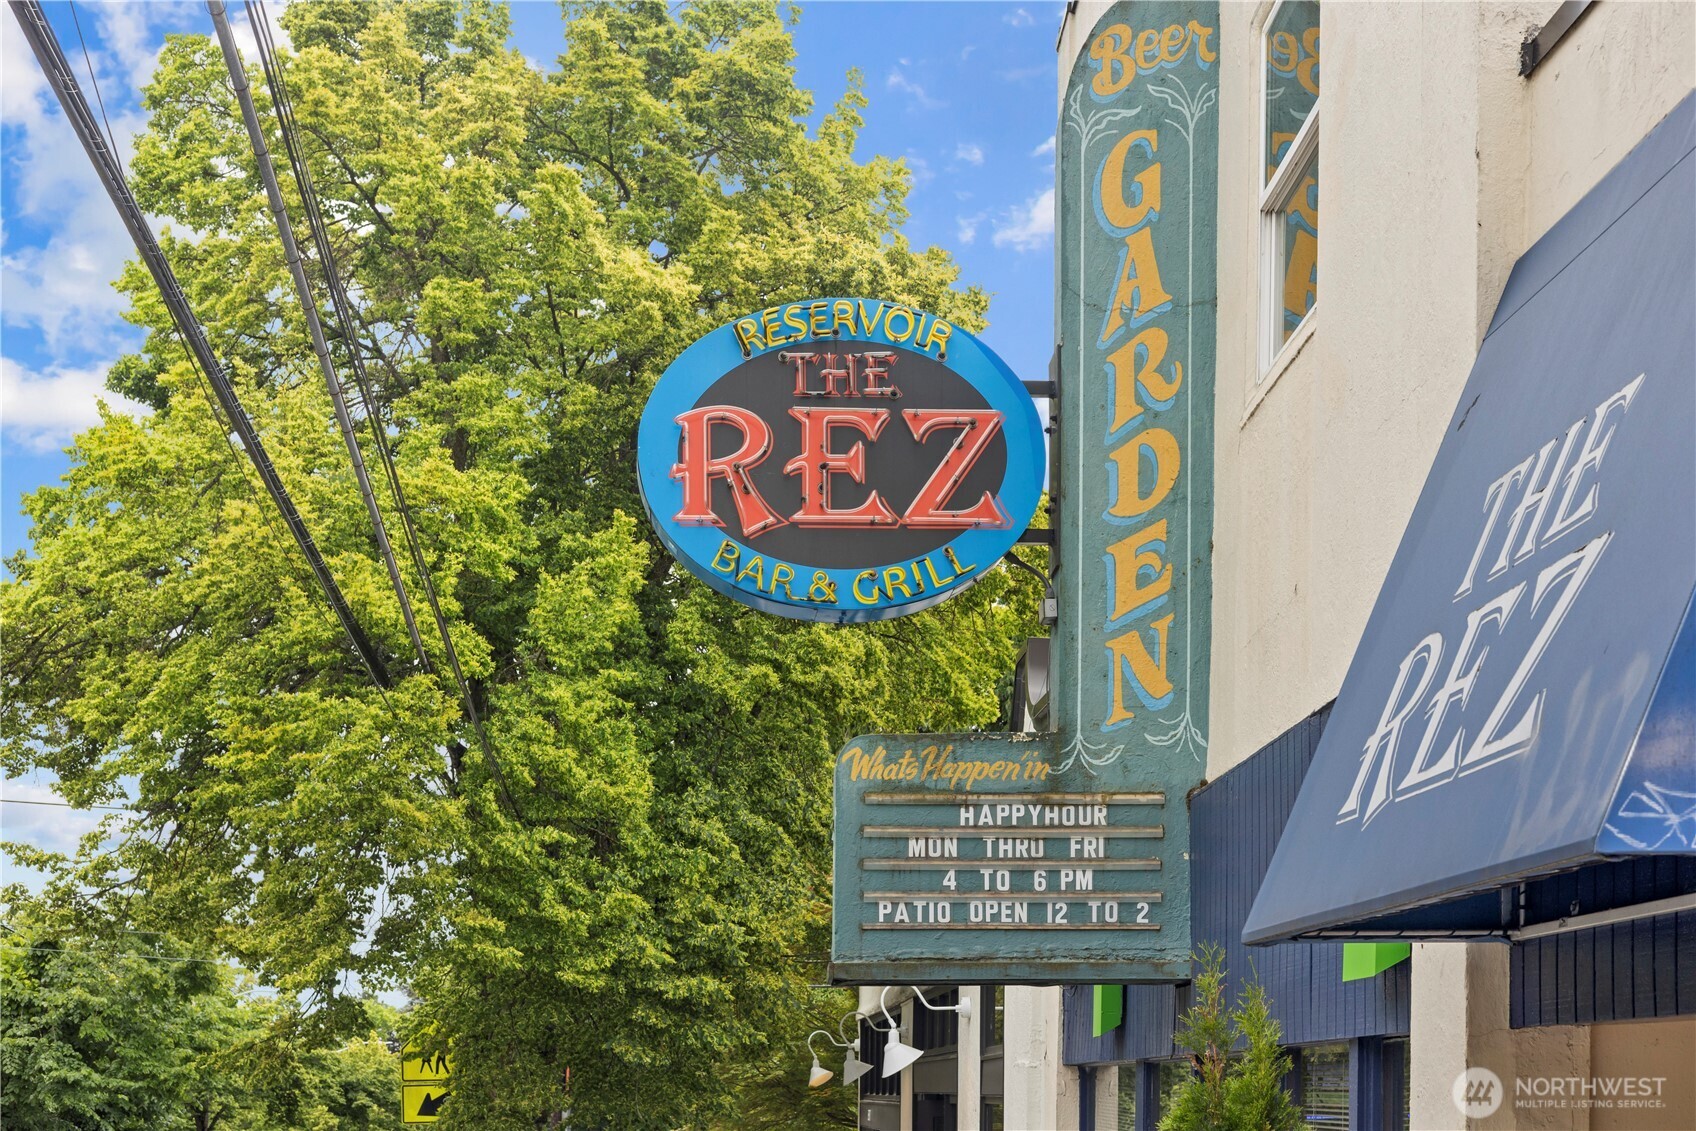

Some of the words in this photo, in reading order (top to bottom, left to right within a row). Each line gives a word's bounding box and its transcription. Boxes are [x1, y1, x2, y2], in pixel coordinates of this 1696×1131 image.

[1089, 20, 1216, 99] Beer
[734, 300, 952, 355] RESERVOIR
[783, 351, 902, 398] THE
[1095, 129, 1182, 731] GARDEN
[669, 405, 1014, 538] REZ
[1453, 372, 1646, 602] THE
[711, 539, 795, 599] BAR
[807, 571, 838, 604] &
[853, 546, 976, 604] GRILL
[1336, 530, 1614, 831] REZ
[908, 836, 957, 858] MON
[983, 836, 1044, 858] THRU
[1070, 836, 1104, 858] FRI
[878, 901, 951, 923] PATIO
[969, 901, 1028, 923] OPEN
[1047, 902, 1068, 924] 12
[1088, 902, 1118, 923] TO
[1136, 902, 1149, 924] 2
[943, 869, 957, 891] 4
[980, 869, 1010, 891] TO
[1033, 870, 1047, 892] 6
[1060, 869, 1093, 891] PM
